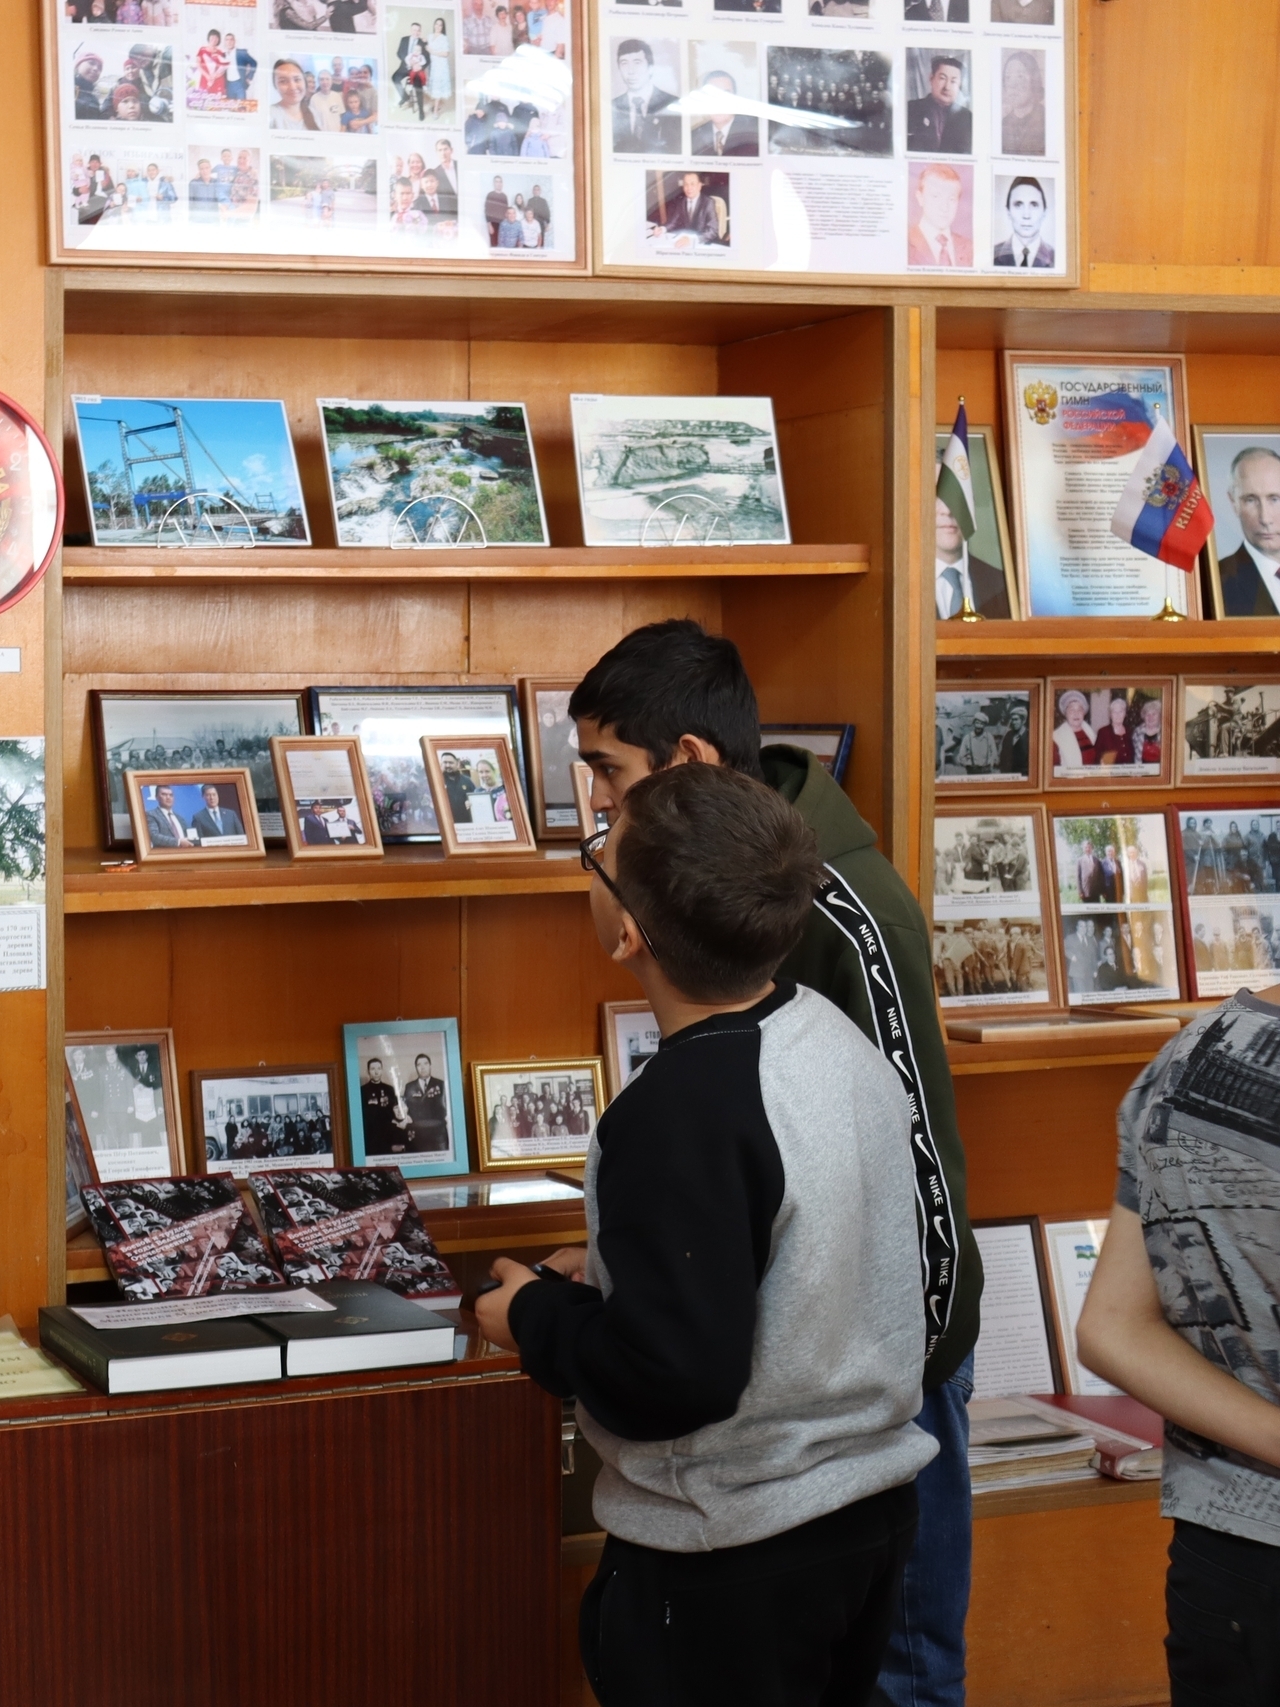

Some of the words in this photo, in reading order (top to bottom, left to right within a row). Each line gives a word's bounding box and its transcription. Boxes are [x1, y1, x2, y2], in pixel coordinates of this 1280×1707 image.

[1060, 381, 1163, 393] ГОСУДАРСТВЕННЫЙ
[1061, 396, 1090, 406] ГИМН
[1062, 408, 1126, 420] РОССИЙСКОЙ
[1063, 421, 1117, 432] ФЕДЕРАЦИИ
[9, 453, 22, 471] 2
[858, 923, 877, 956] NIKE
[886, 1007, 902, 1040] NIKE
[907, 1092, 920, 1124] NIKE
[928, 1174, 944, 1207] NIKE
[938, 1257, 950, 1287] NIKE
